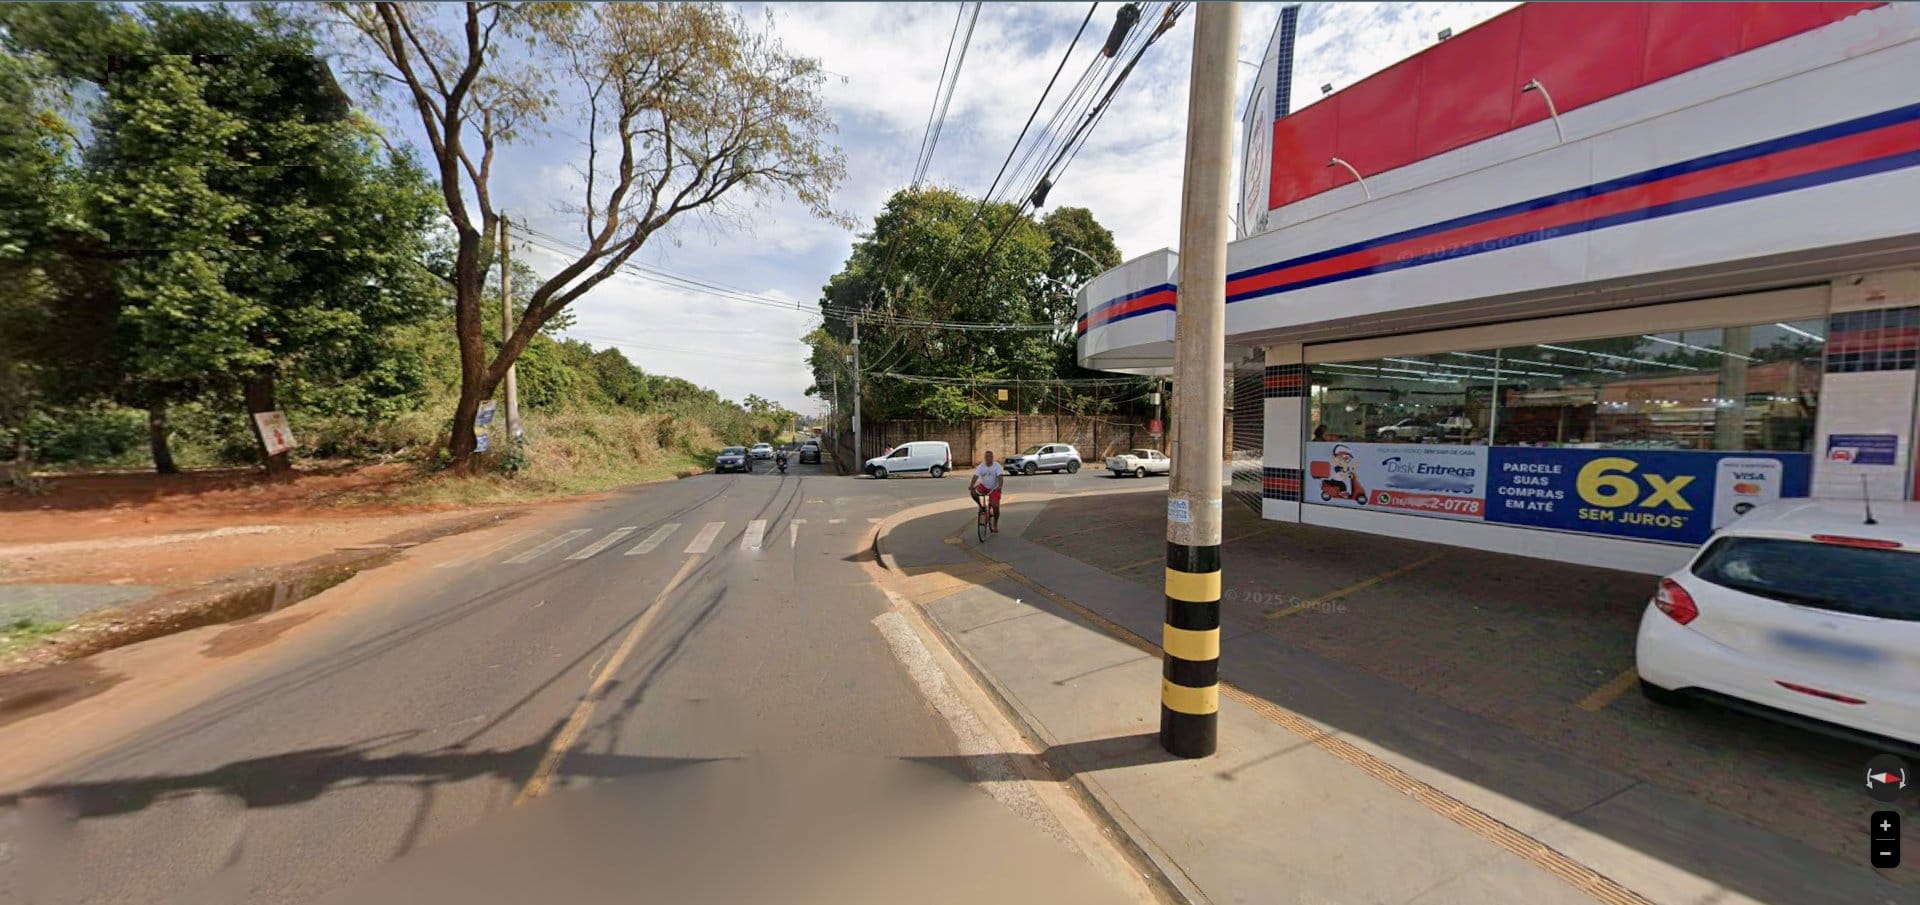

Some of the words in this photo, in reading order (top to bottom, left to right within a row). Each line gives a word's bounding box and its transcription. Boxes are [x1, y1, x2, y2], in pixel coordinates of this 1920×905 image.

[1387, 461, 1414, 474] Disk
[1417, 463, 1475, 477] Entrega
[1502, 462, 1563, 475] PARCELE
[1513, 474, 1549, 486] SUAS
[1731, 471, 1767, 480] VISA
[1576, 456, 1696, 511] 6x
[1498, 486, 1564, 500] COMPRAS
[1505, 499, 1525, 510] EM
[1527, 500, 1554, 512] ATÉ
[1578, 508, 1614, 521] SEM
